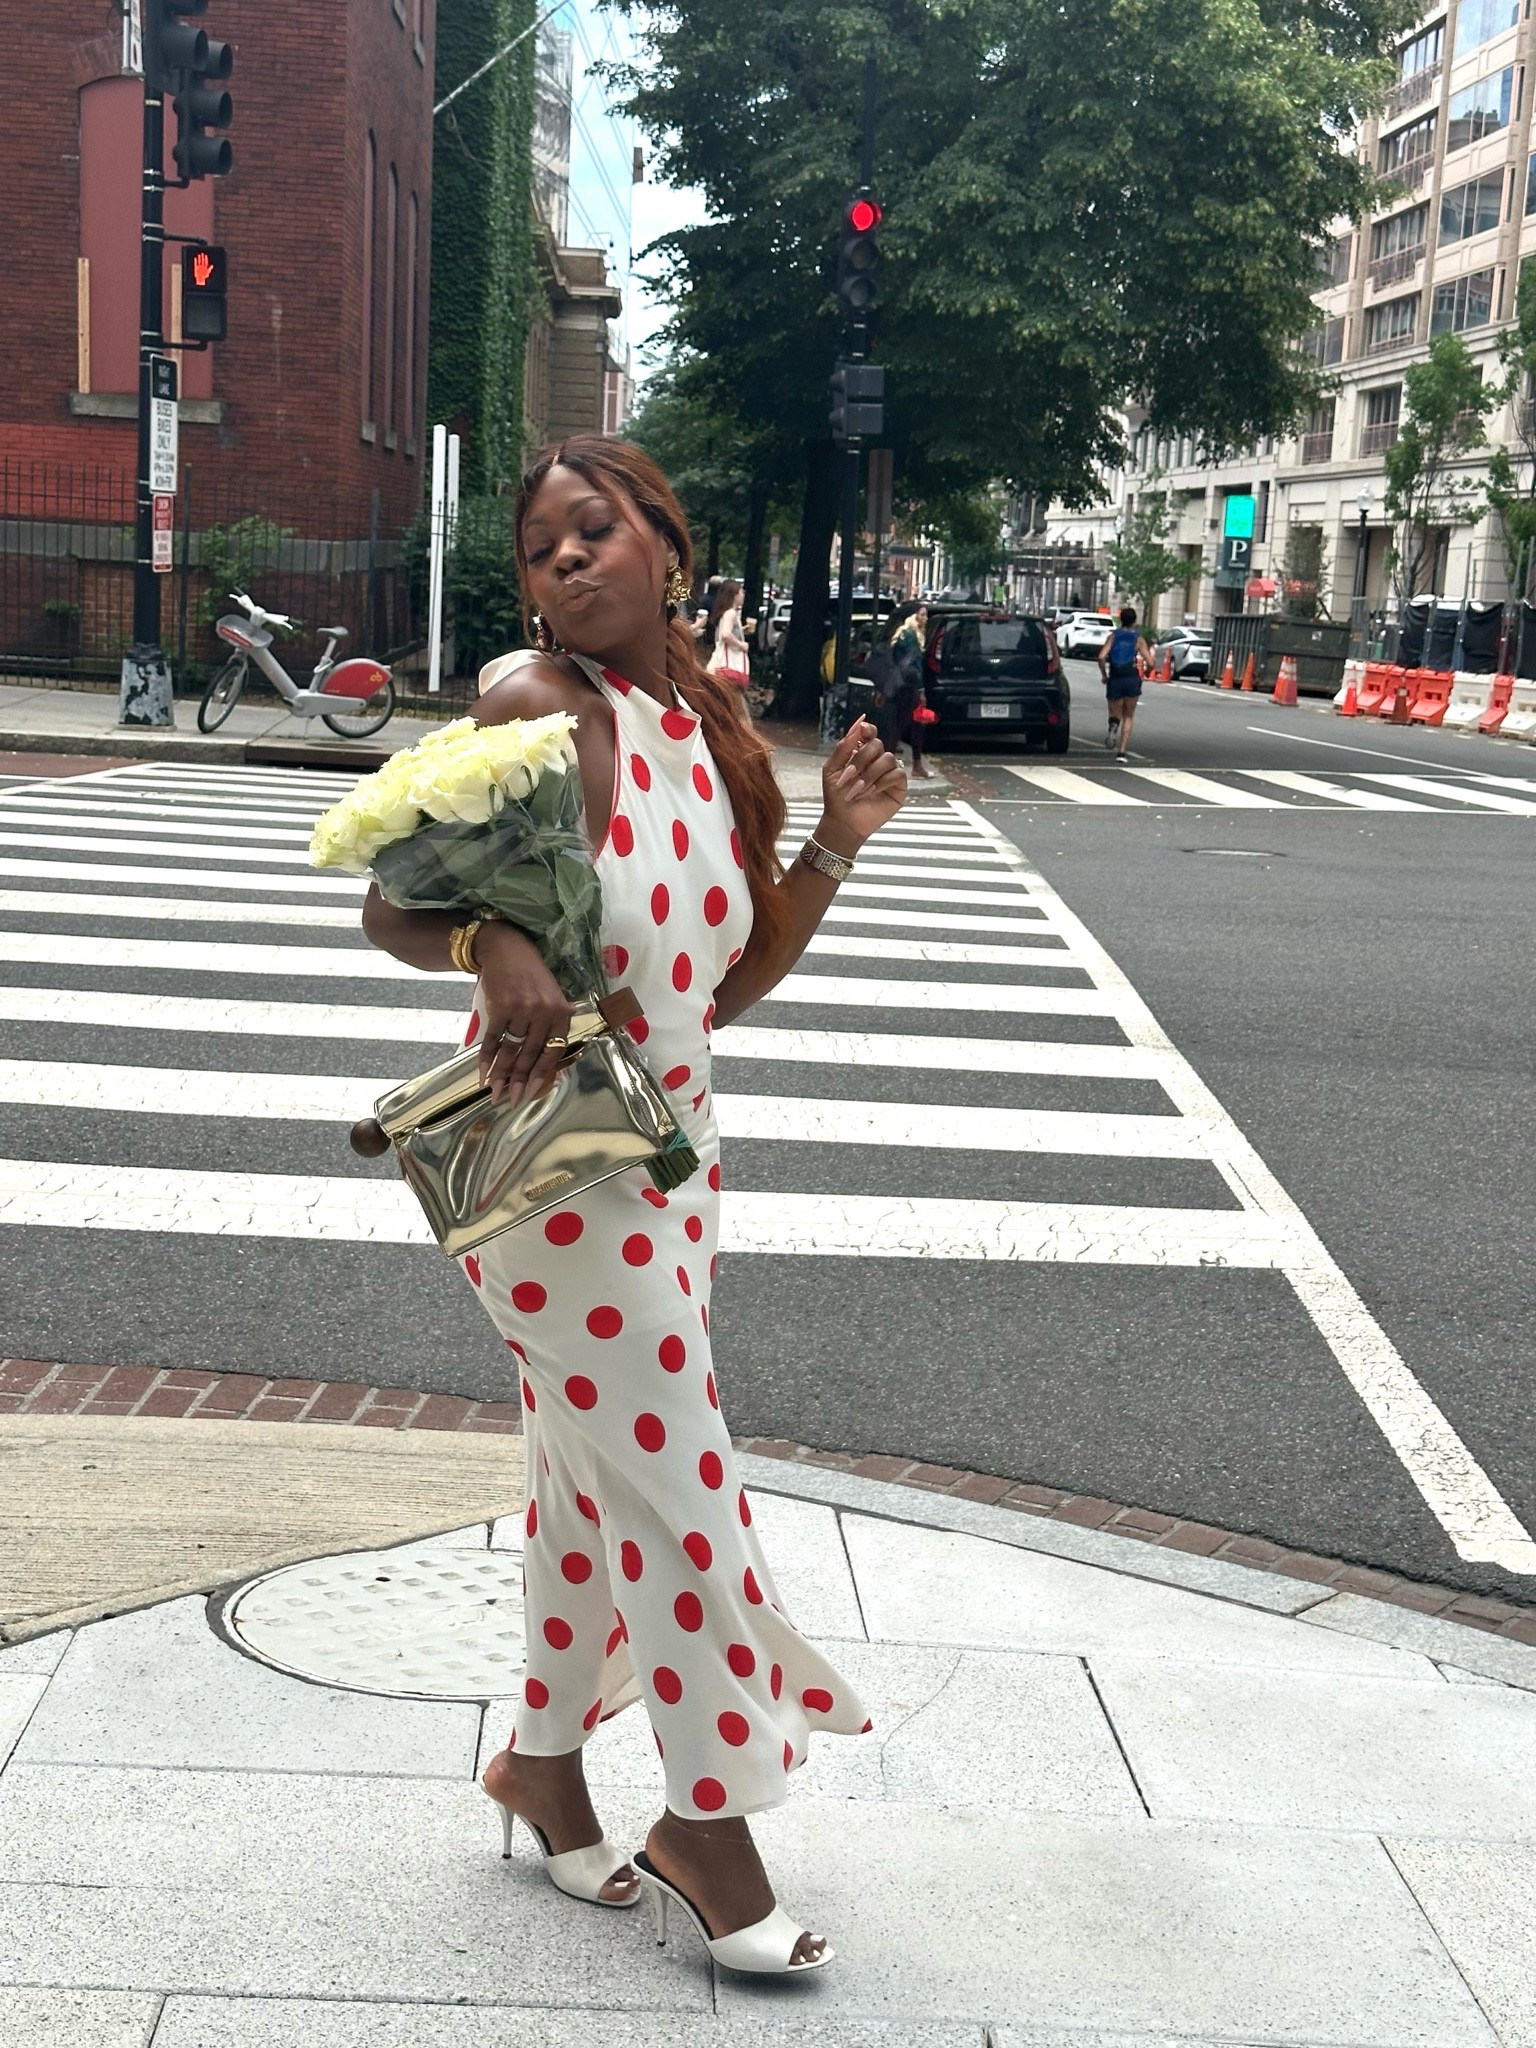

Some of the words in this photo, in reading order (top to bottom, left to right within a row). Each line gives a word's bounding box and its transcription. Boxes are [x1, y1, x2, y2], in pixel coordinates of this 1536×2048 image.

[157, 401, 173, 417] BUSES
[157, 418, 172, 434] BIKES
[157, 434, 171, 449] ONLY
[1231, 540, 1248, 561] P
